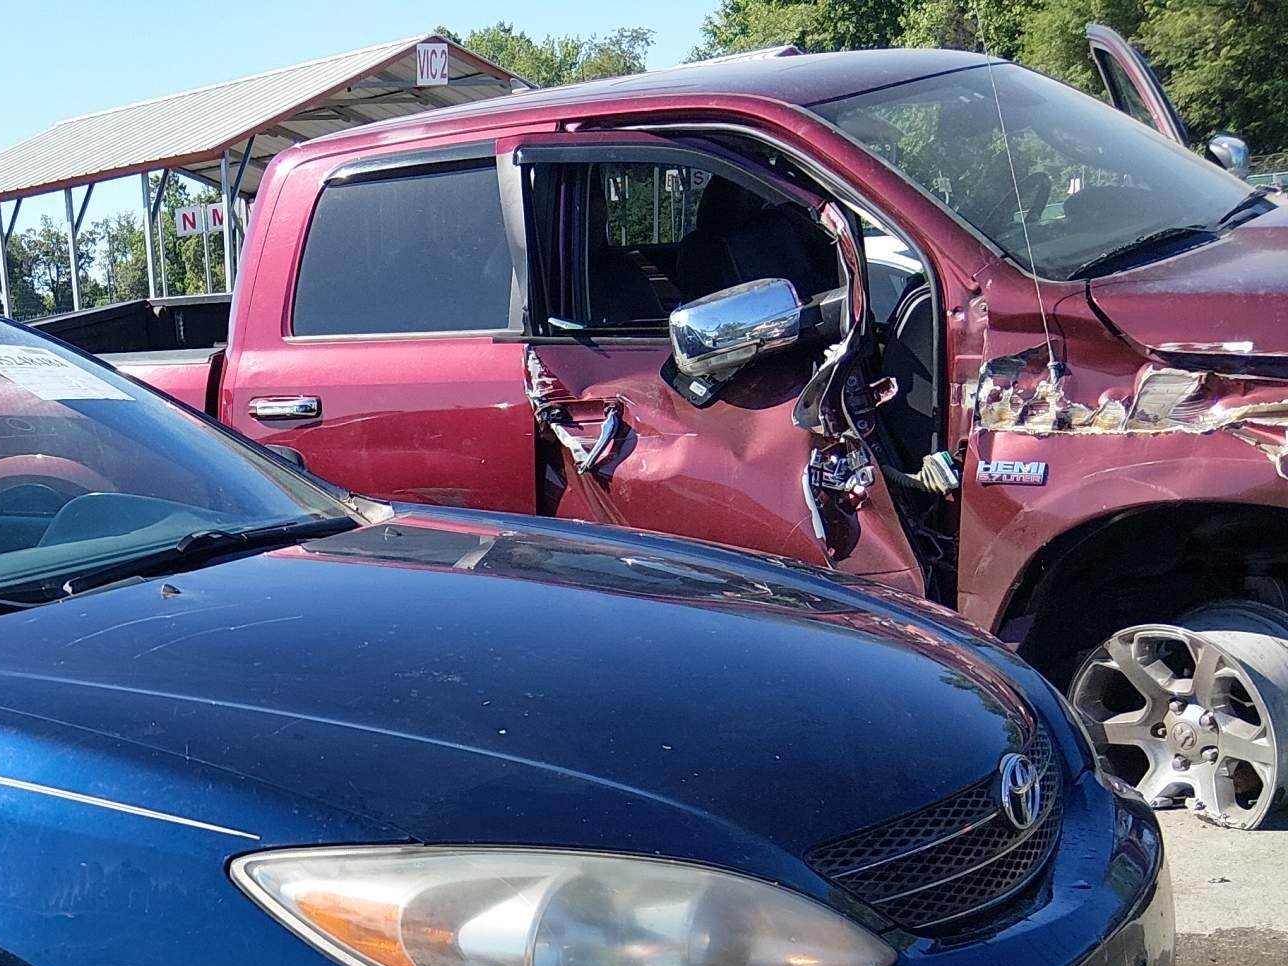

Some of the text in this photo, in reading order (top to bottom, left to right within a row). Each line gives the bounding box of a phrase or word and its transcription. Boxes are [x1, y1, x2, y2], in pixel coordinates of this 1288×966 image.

[417, 49, 447, 80] VIC 2
[182, 211, 197, 232] N
[977, 460, 1046, 474] HEMI
